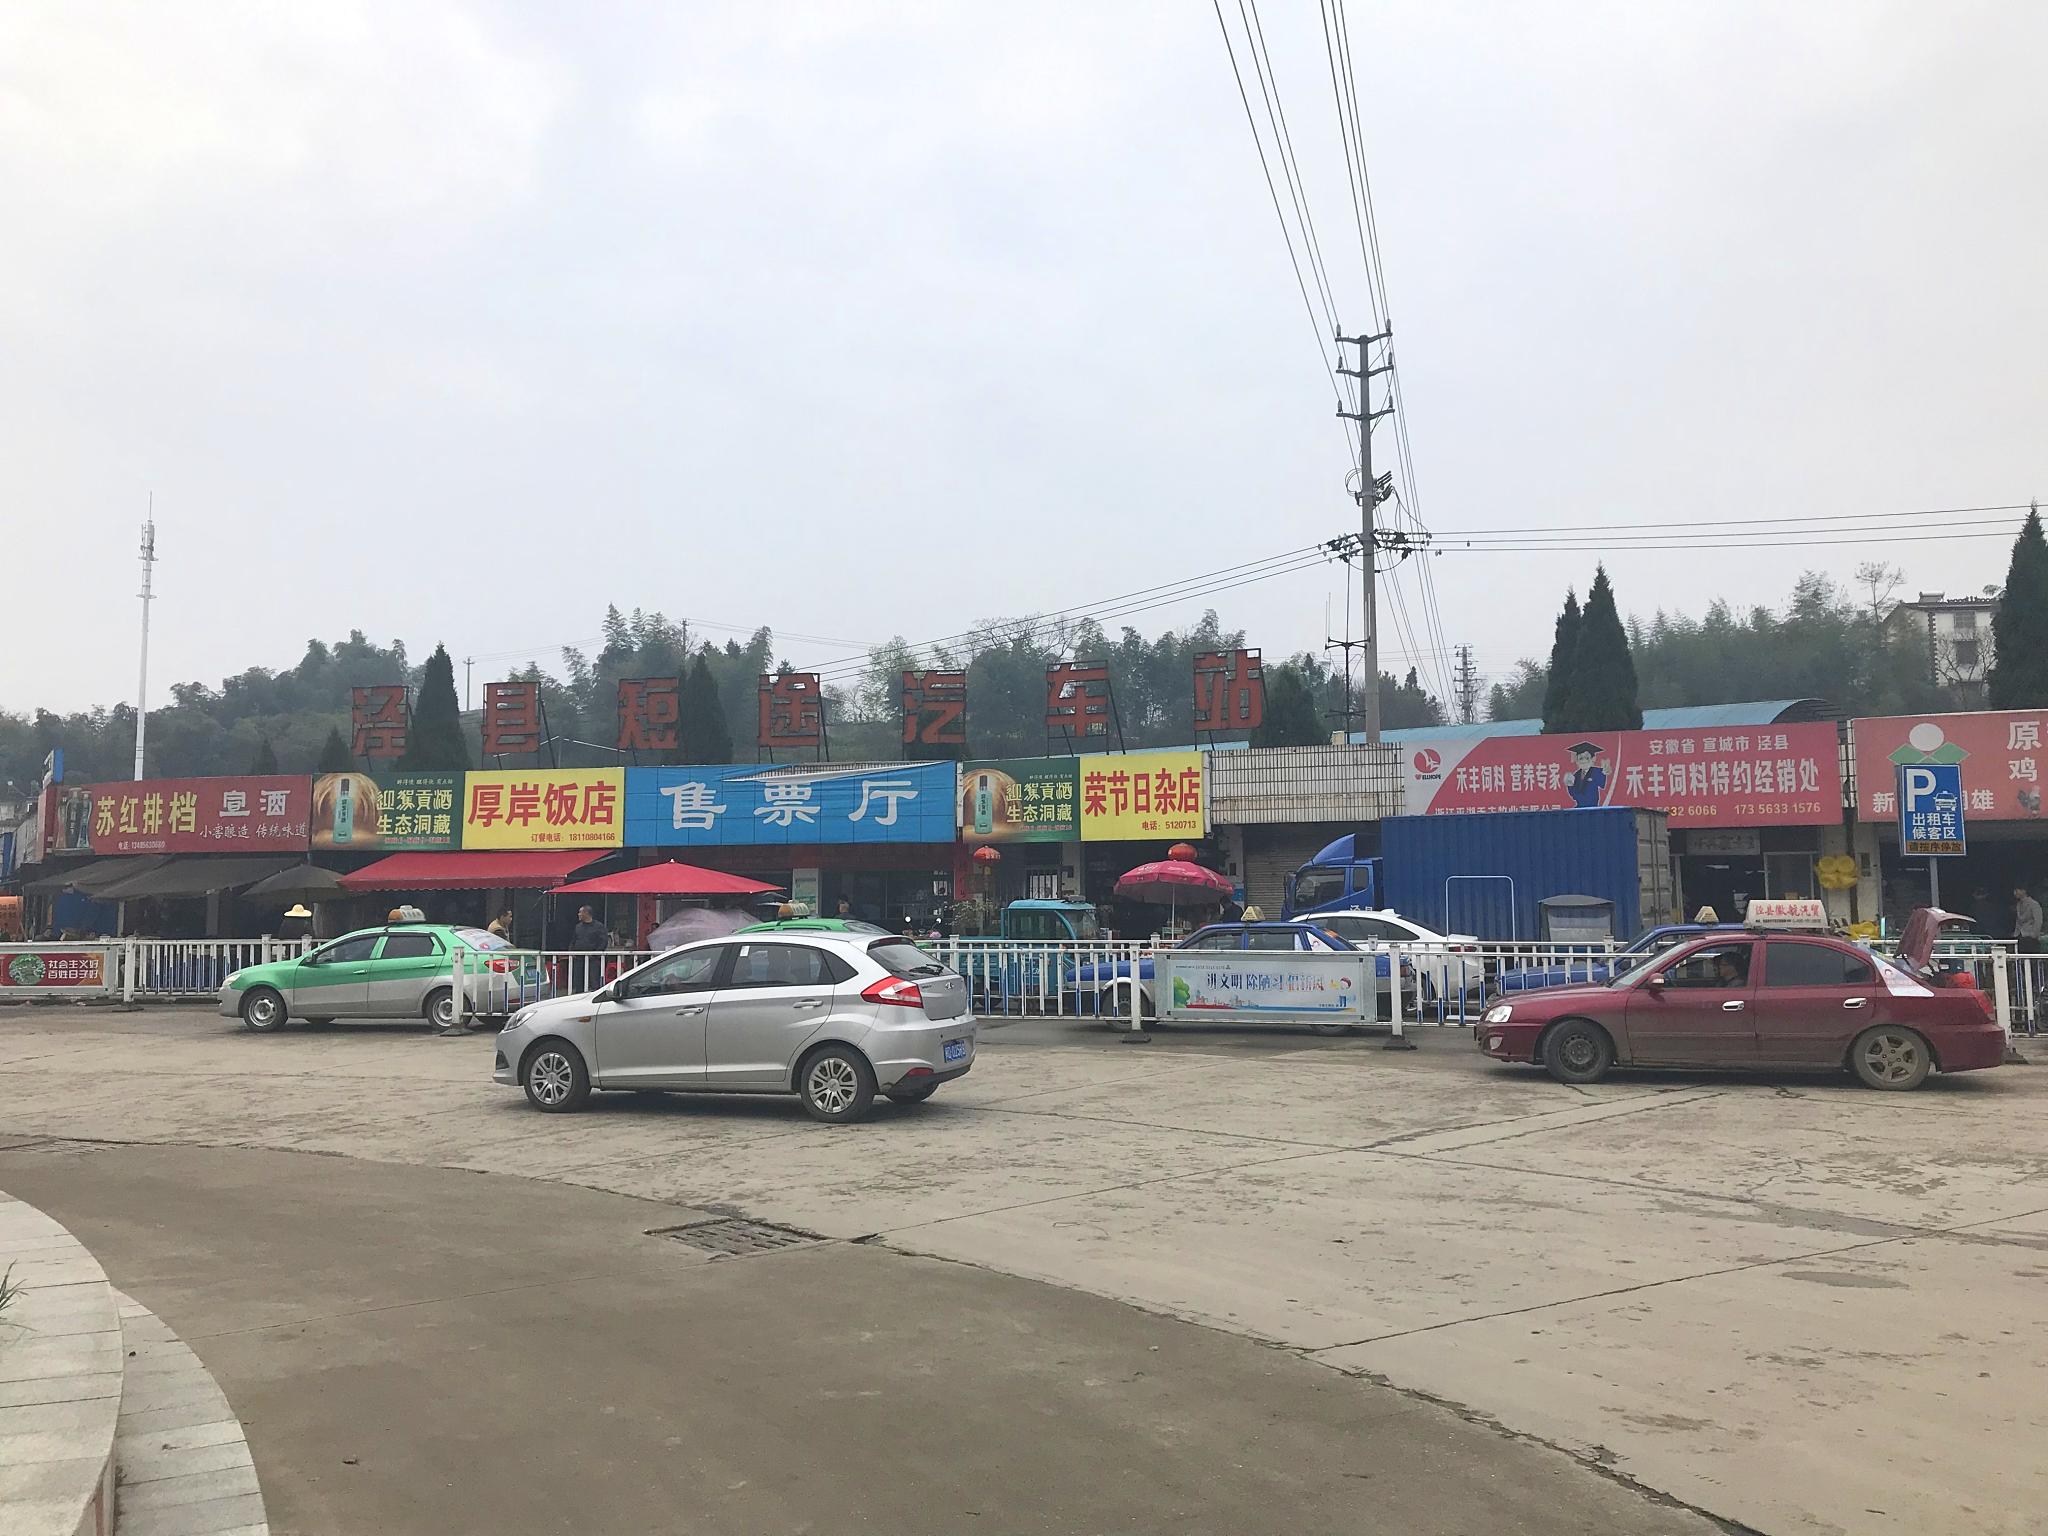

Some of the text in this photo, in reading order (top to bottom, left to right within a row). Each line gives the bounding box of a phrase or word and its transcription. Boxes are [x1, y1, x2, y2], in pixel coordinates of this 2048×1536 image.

[1649, 735, 1790, 755] 安徽省 宣城市 泾县
[2007, 720, 2048, 750] 原
[1456, 762, 1561, 794] 禾丰饲料 营养专家
[1626, 758, 1820, 798] 禾丰饲料特约经销处
[1084, 766, 1201, 817] 荣节日杂店
[1906, 768, 1937, 812] P
[95, 791, 198, 836] 苏红排档
[219, 790, 291, 817] 宣酒
[468, 780, 617, 828] 厚岸饭店
[660, 780, 918, 830] 售票厅
[1006, 803, 1073, 823] 生态洞藏
[1688, 805, 1717, 816] 6066
[1734, 803, 1754, 814] 173
[1758, 803, 1788, 814] 5633
[1792, 801, 1821, 813] 1576
[376, 814, 451, 835] 生态洞藏
[1165, 820, 1197, 830] 5120713
[1912, 812, 1956, 826] 出租车
[199, 821, 308, 839] 小窖酿造 传统味道
[1912, 826, 1957, 840] 候客区
[48, 960, 99, 969] 社会主义好
[48, 970, 99, 979] 百姓日子好
[1207, 972, 1242, 990] 讲文明
